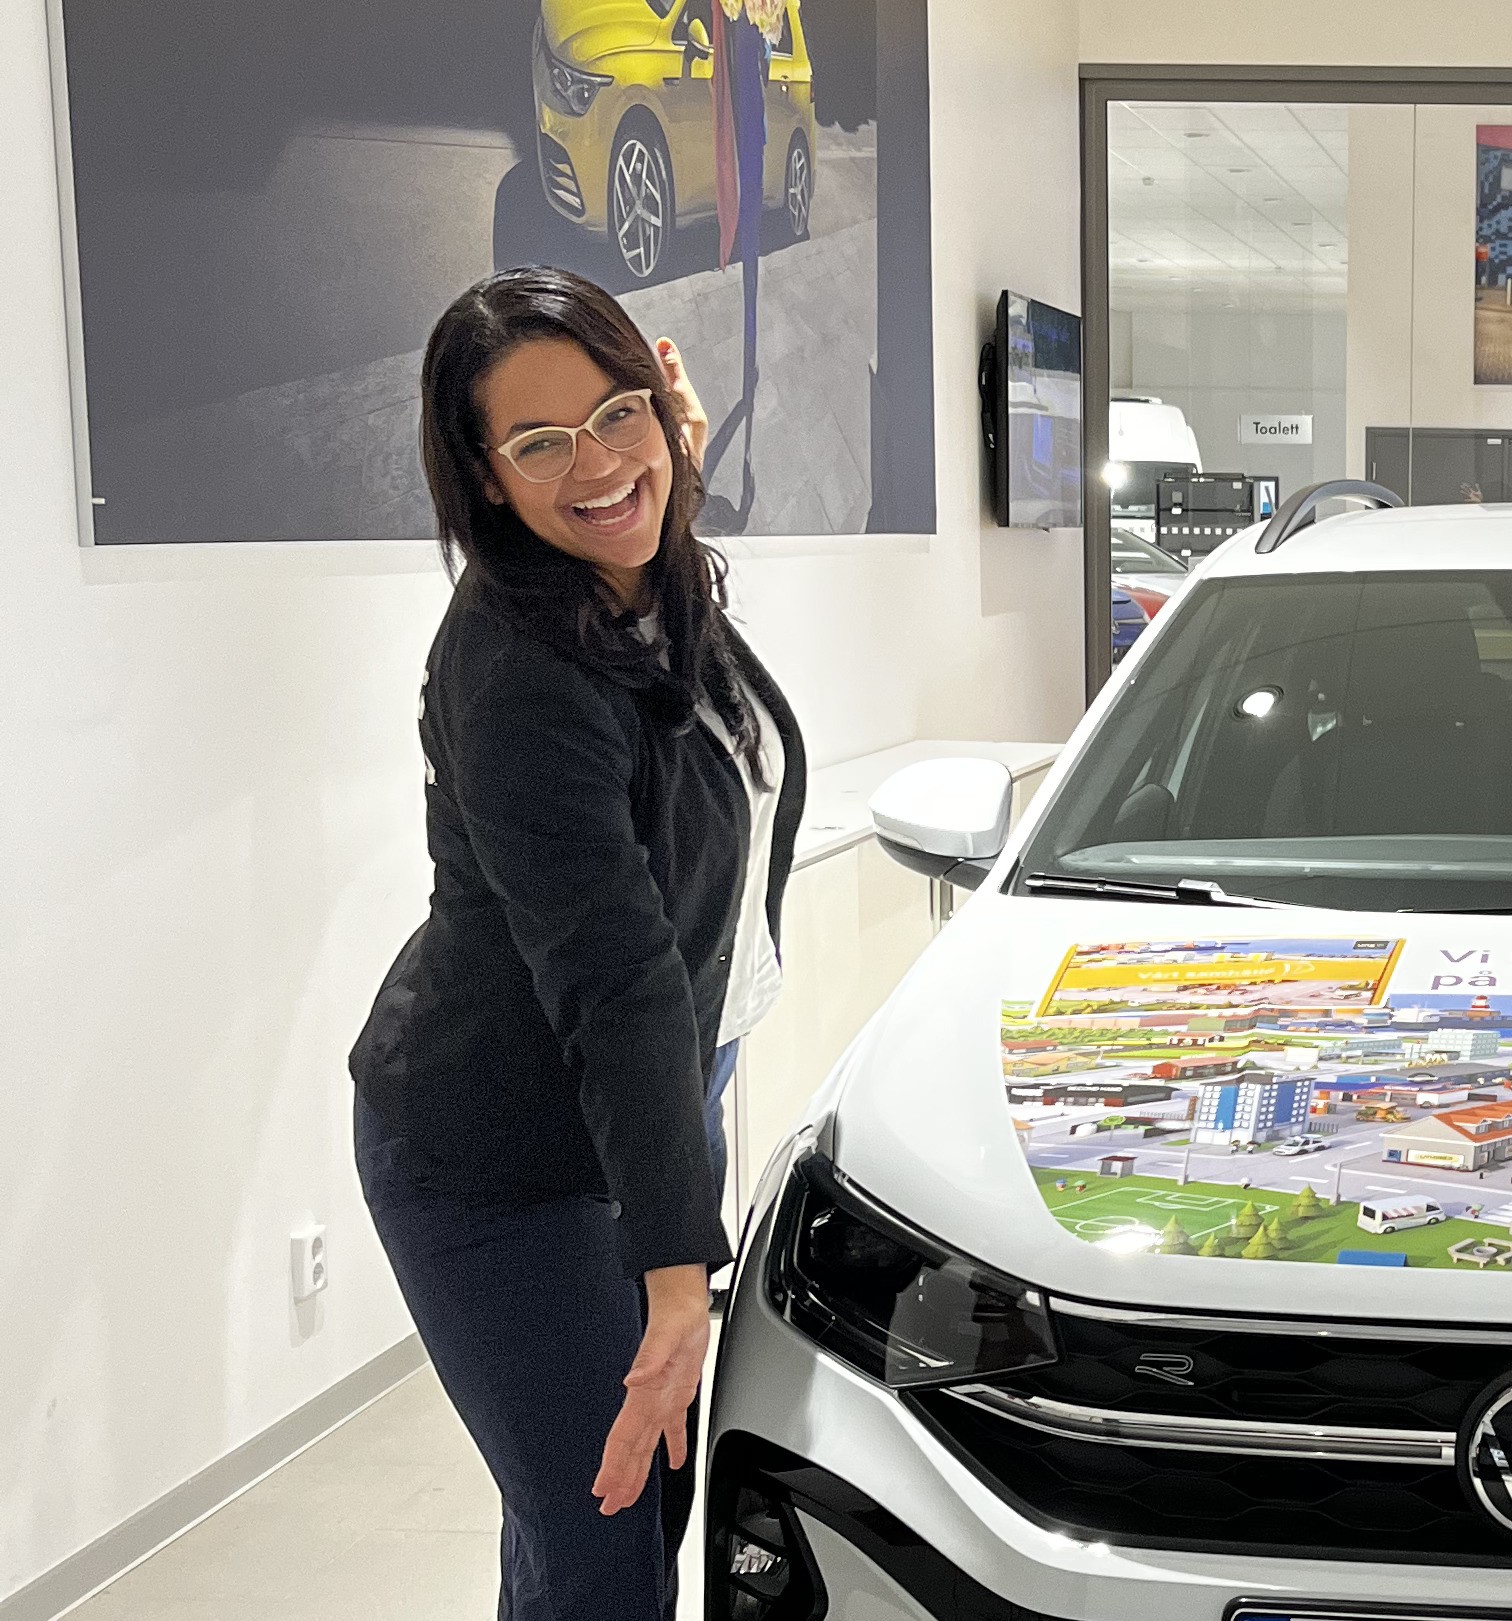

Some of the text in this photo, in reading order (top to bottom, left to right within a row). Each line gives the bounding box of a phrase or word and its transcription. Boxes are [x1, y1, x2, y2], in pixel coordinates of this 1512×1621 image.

[1252, 421, 1300, 435] Toalett
[1440, 950, 1491, 964] Vi
[1430, 970, 1497, 991] på
